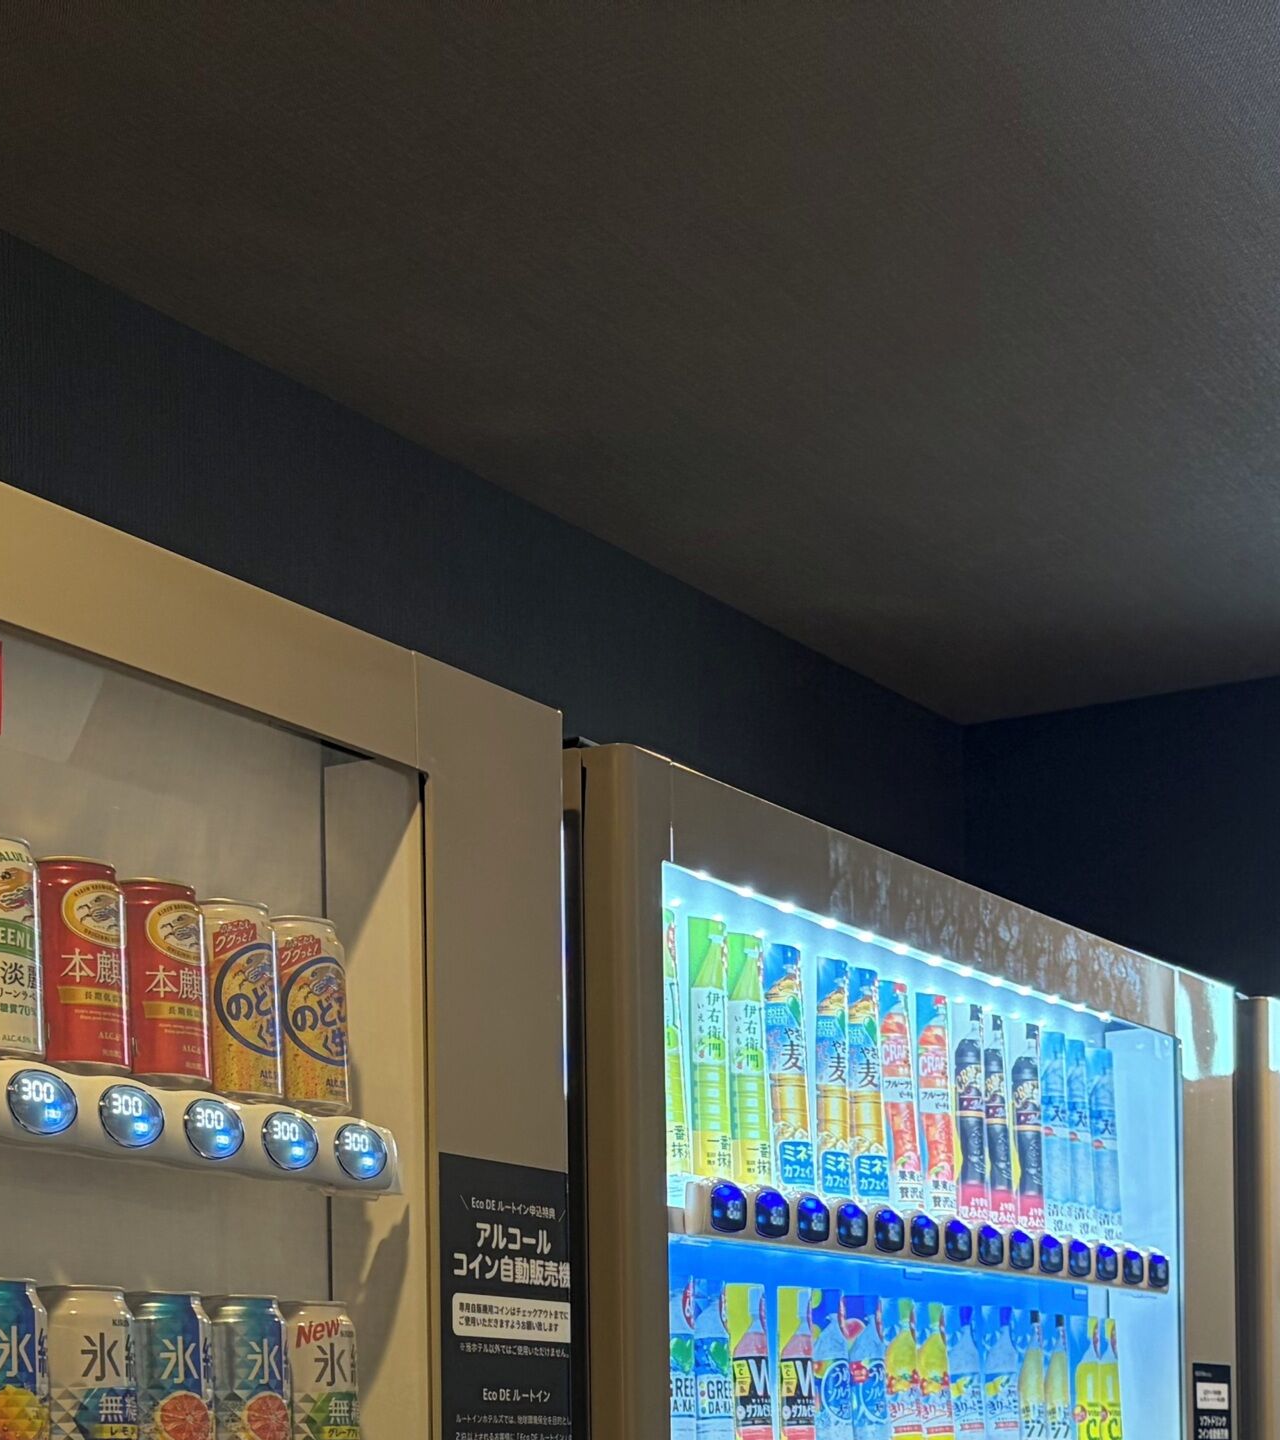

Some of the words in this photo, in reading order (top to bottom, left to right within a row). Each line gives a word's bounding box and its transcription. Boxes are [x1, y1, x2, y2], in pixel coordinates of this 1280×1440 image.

[20, 1080, 55, 1104] 300
[113, 1094, 144, 1117] 300
[196, 1109, 224, 1129] 300
[272, 1121, 299, 1142] 300
[345, 1132, 369, 1153] 300
[475, 1221, 552, 1255] アルコール
[453, 1252, 571, 1290] コイン自動販売機
[295, 1319, 341, 1350] New
[483, 1388, 498, 1401] Eco
[500, 1388, 511, 1401] DE
[513, 1388, 552, 1403] ルートイン
